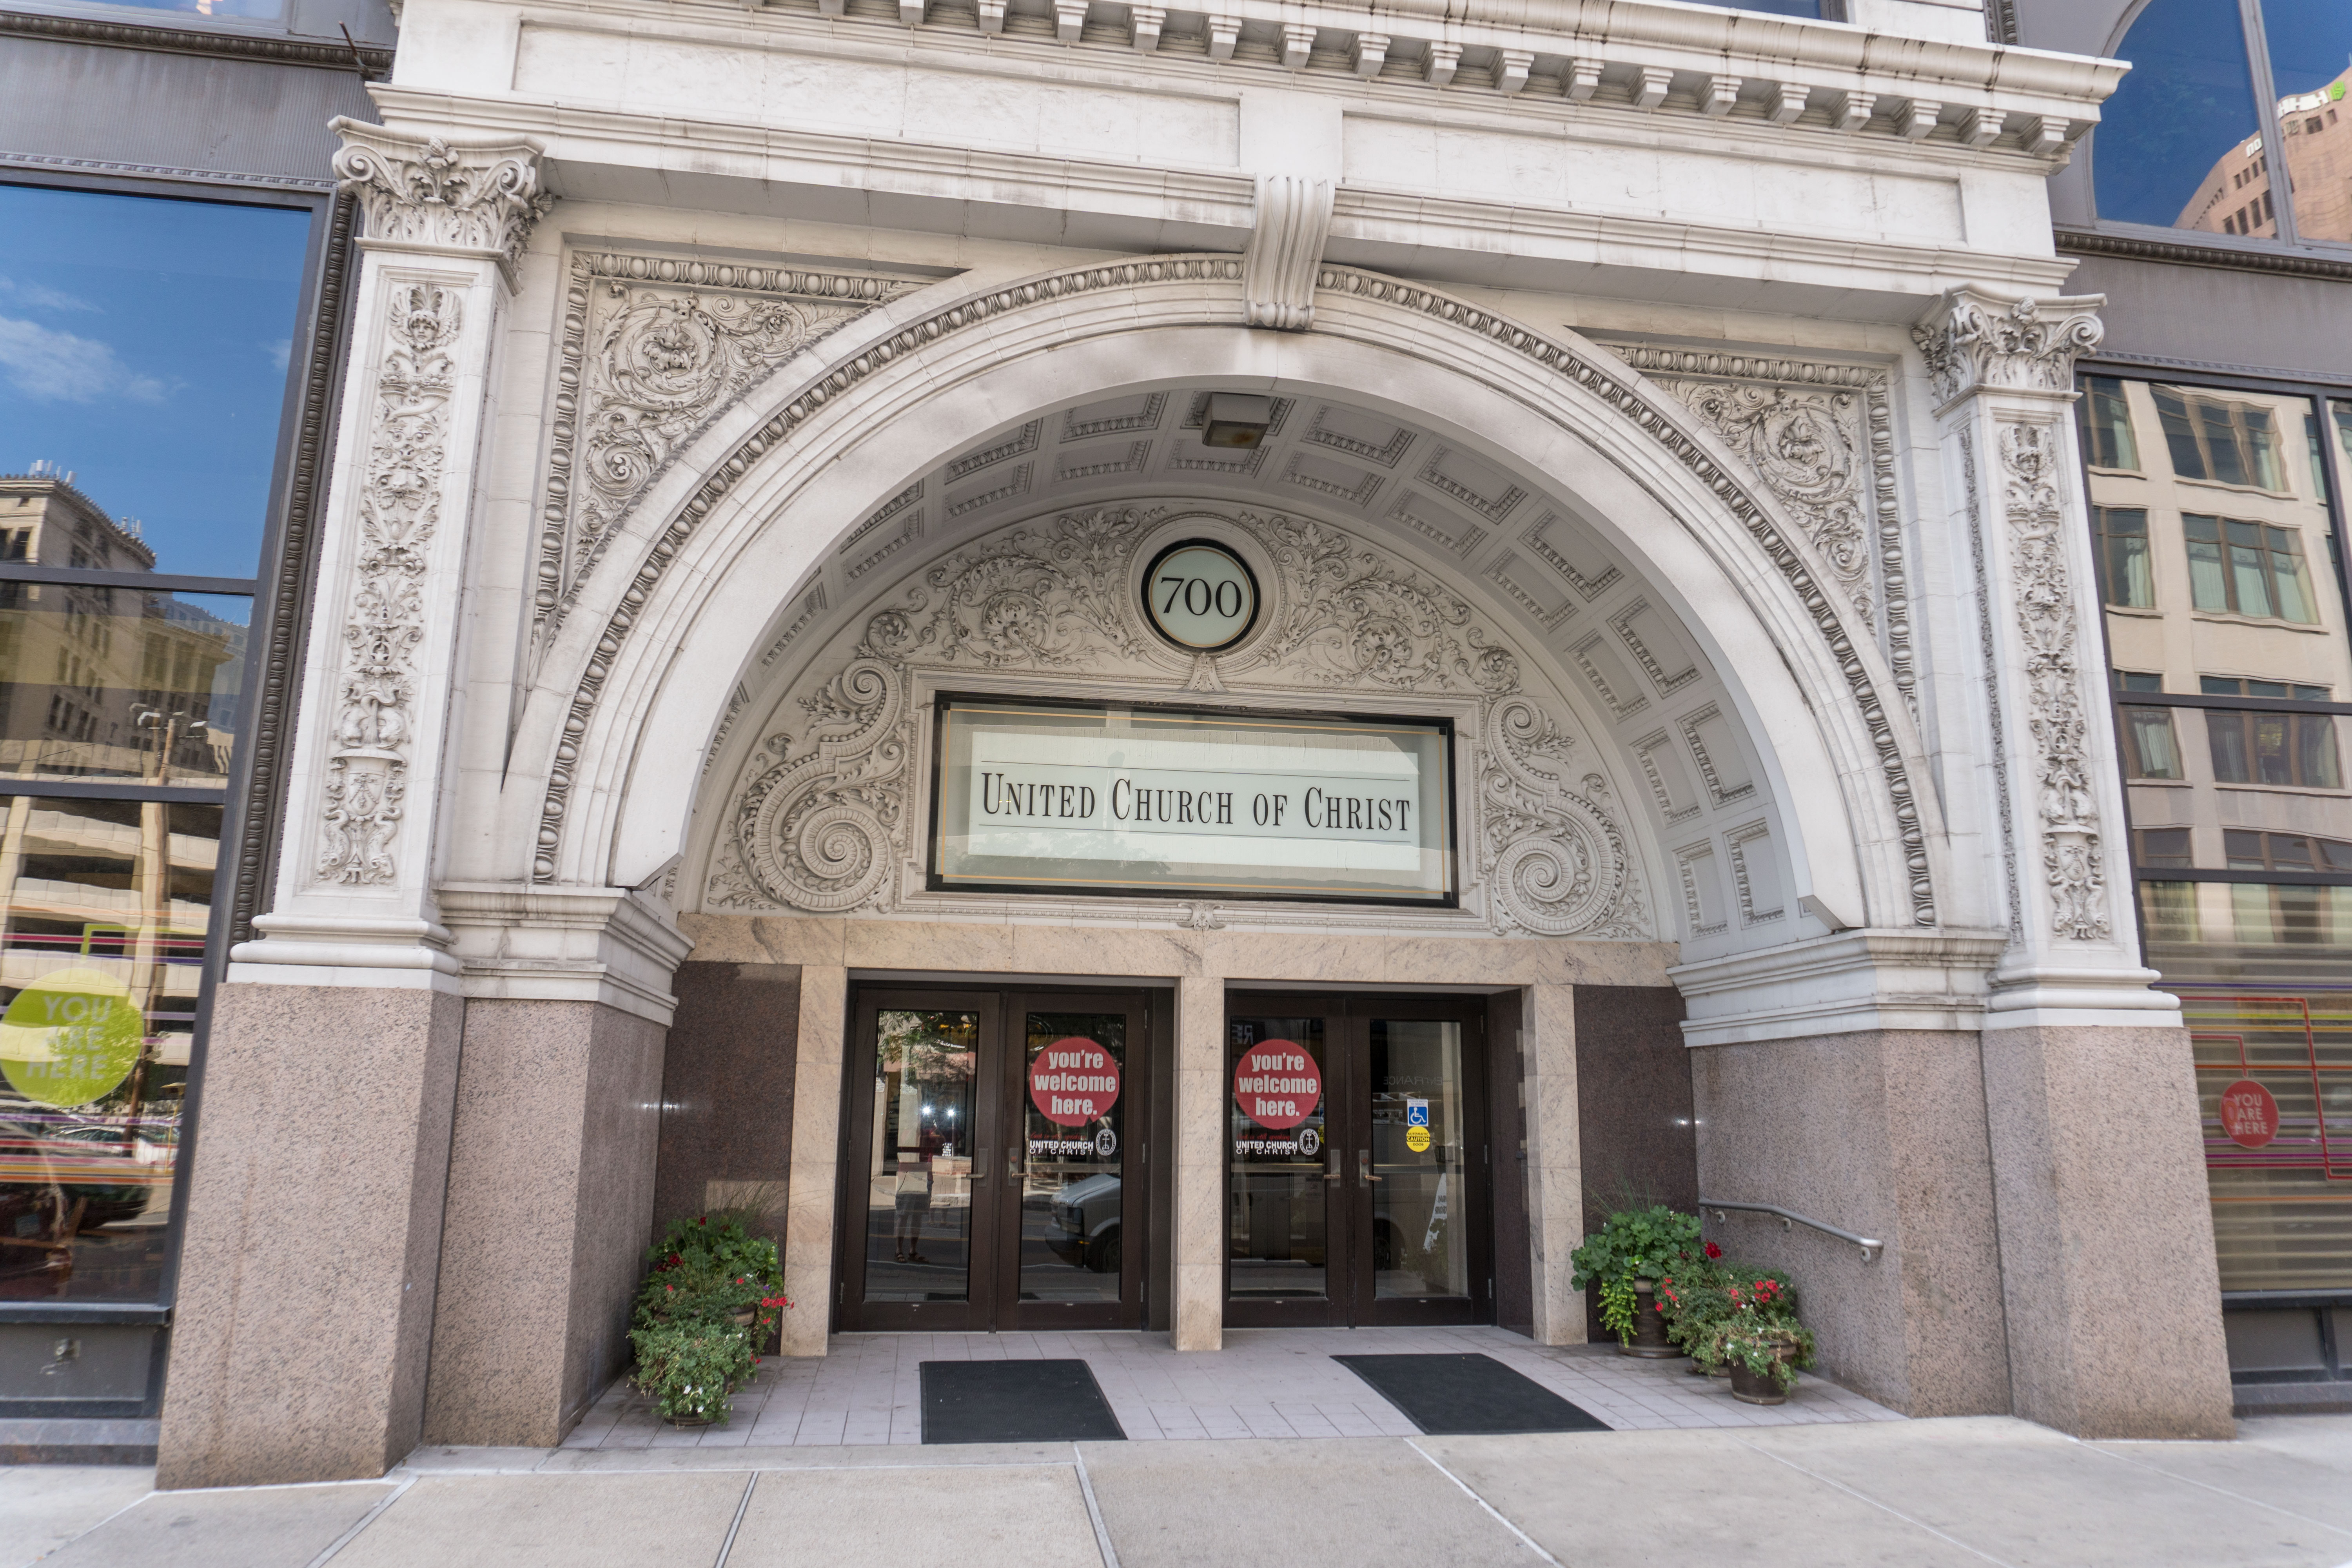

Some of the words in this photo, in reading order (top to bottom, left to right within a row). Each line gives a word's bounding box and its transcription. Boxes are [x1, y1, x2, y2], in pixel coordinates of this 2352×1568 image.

[1161, 577, 1242, 617] 700
[981, 773, 1095, 818] UNITED
[1112, 779, 1233, 824] CHURCH
[1253, 793, 1287, 826] OF
[1305, 787, 1410, 831] CHRIST
[43, 996, 113, 1022] YOU
[40, 1025, 105, 1051] ARE
[26, 1053, 109, 1080] HERE
[1048, 1049, 1103, 1069] you're
[1251, 1052, 1304, 1072] you're
[1034, 1072, 1116, 1092] welcome
[1238, 1074, 1317, 1094] welcome
[1051, 1095, 1097, 1115] here.
[1256, 1097, 1300, 1116] here.
[2234, 1094, 2262, 1107] YOU
[2238, 1108, 2263, 1120] ARE
[2235, 1122, 2268, 1134] HERE
[1029, 1140, 1059, 1149] UNITED
[1061, 1141, 1094, 1150] CHURCH
[1236, 1140, 1264, 1149] UNITED
[1266, 1141, 1298, 1149] CHURCH
